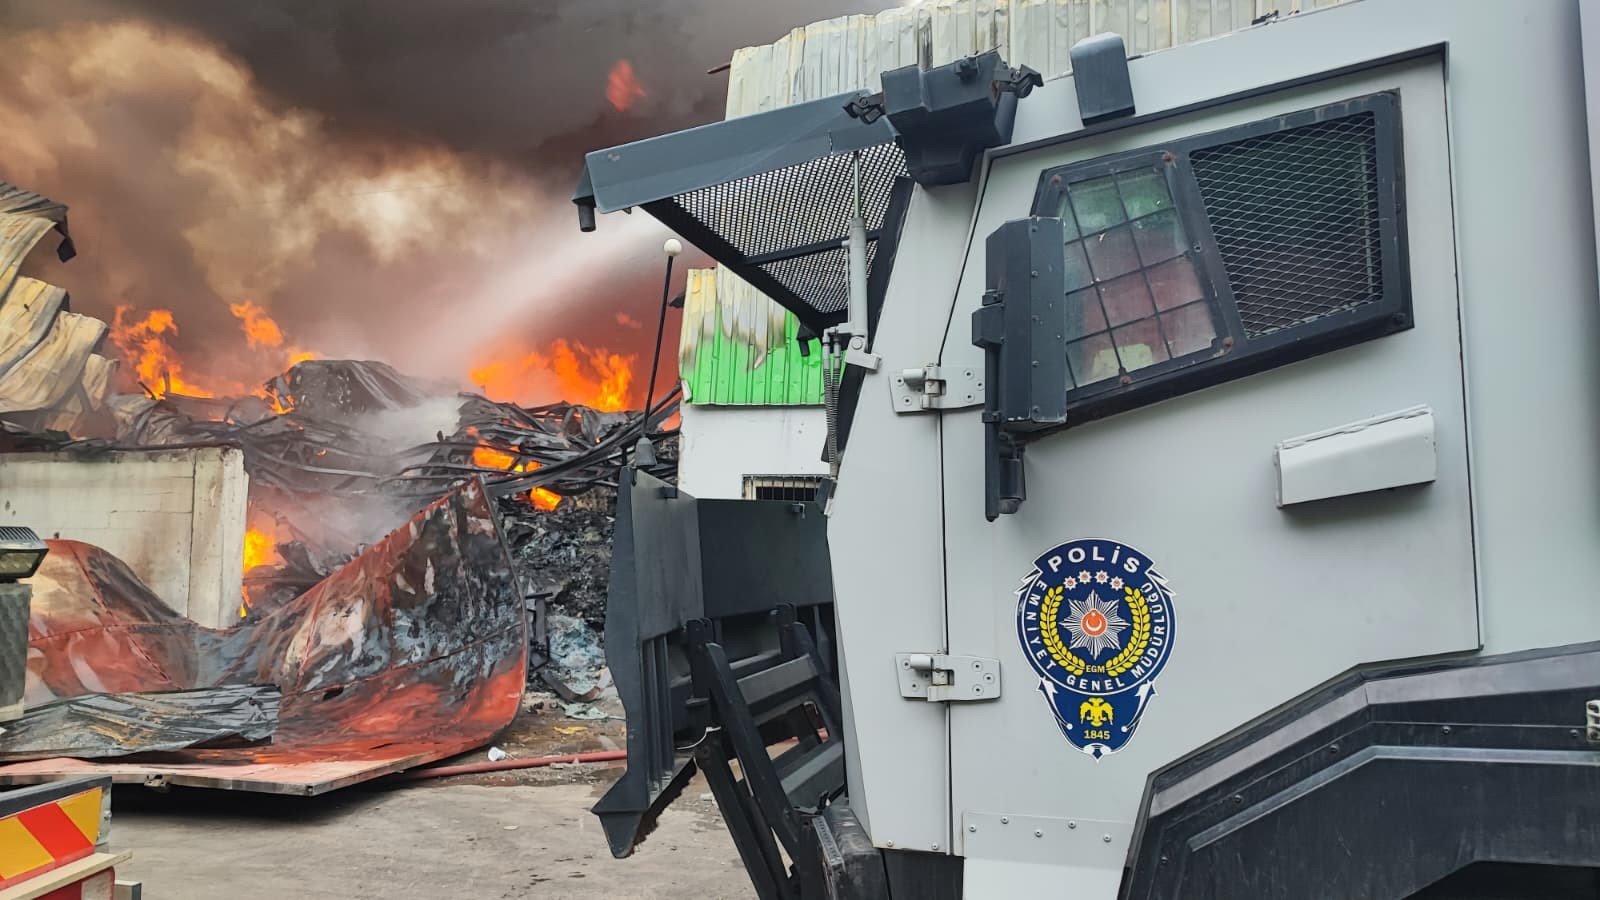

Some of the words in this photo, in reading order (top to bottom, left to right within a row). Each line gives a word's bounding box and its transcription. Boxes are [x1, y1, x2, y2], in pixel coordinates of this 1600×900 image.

[1047, 545, 1141, 573] POLİS
[1066, 674, 1125, 691] GENEL
[1130, 582, 1165, 679] MÜDÜRLÜĞÜ
[1085, 664, 1106, 673] EGM
[1083, 729, 1111, 740] 1845
